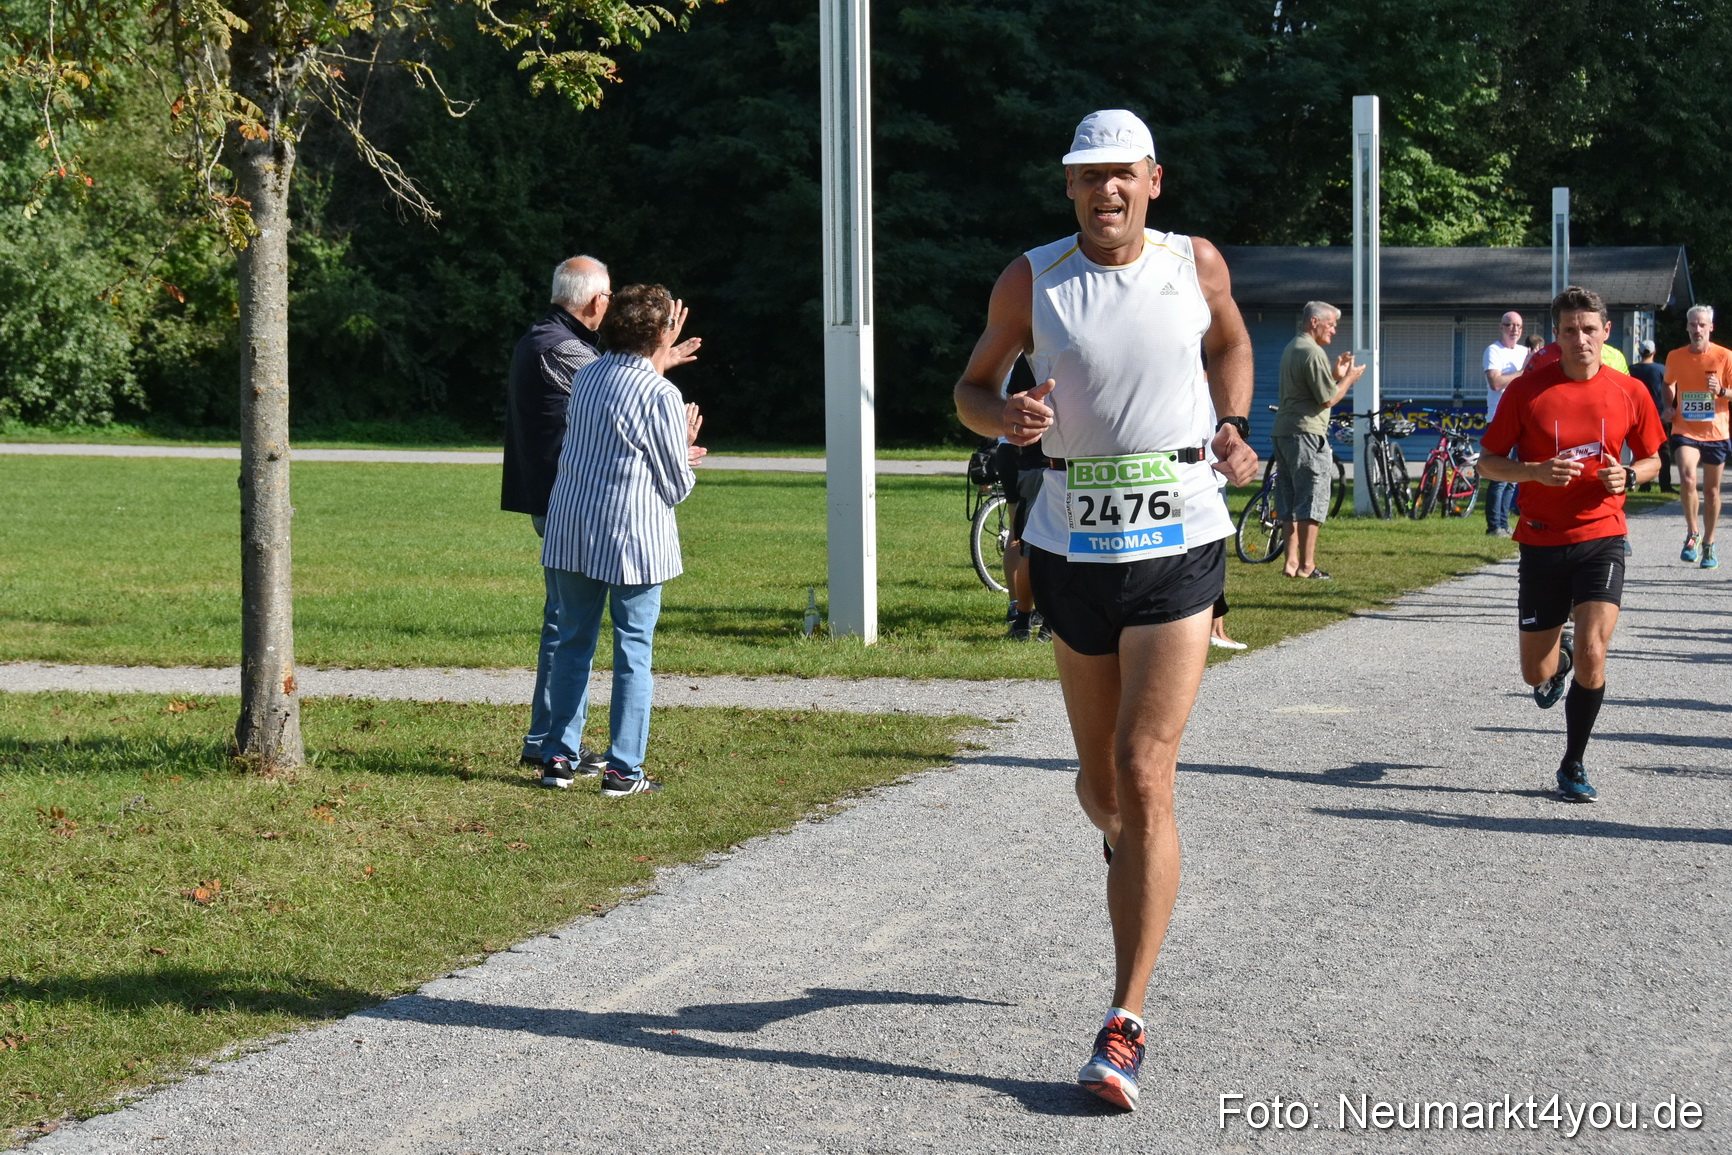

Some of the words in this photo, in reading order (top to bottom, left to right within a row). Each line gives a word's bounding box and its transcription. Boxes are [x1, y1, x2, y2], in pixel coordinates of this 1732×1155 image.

[1684, 402, 1711, 412] 2538
[1075, 459, 1168, 484] BOCK
[1078, 490, 1171, 526] 2476
[1088, 531, 1163, 551] THOMAS
